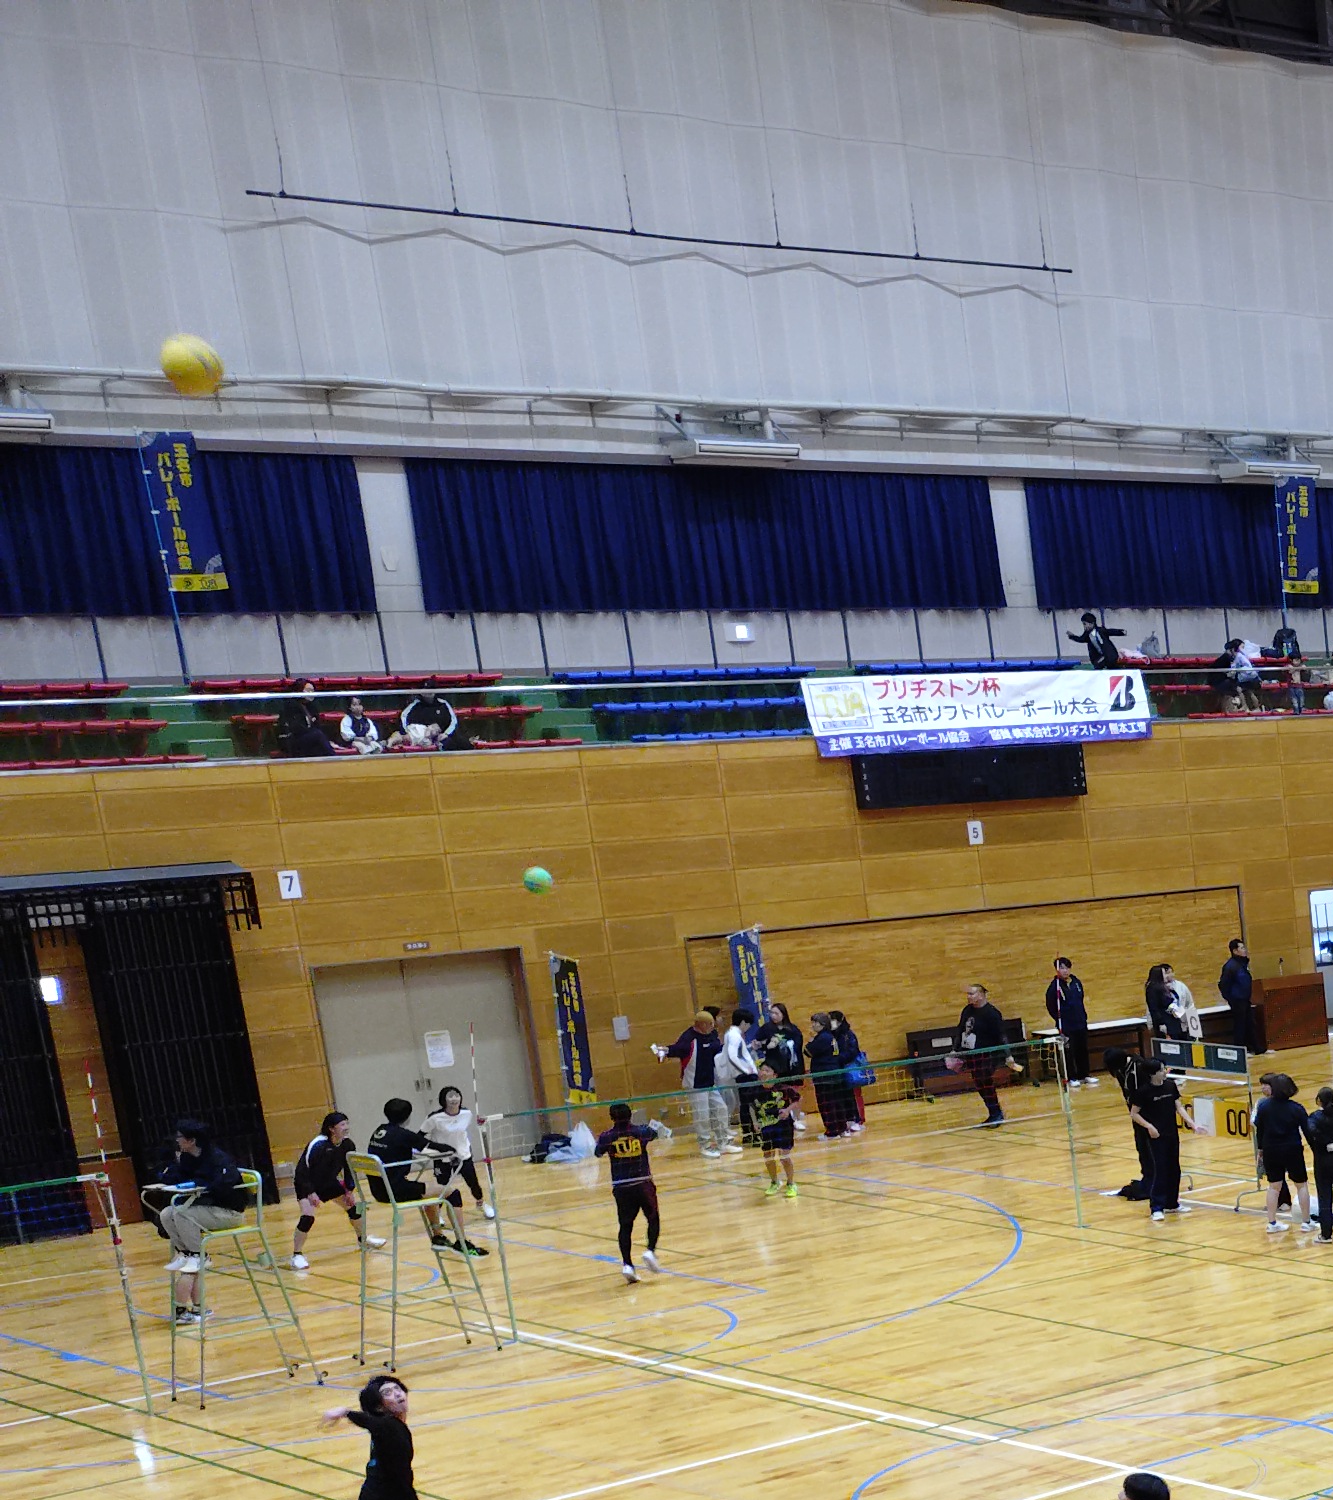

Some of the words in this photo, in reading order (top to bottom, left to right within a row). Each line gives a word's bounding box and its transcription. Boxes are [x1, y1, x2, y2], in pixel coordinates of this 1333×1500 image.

[872, 677, 1001, 700] ブリヂストン杯
[878, 697, 1100, 724] 玉名市ソフトバレーボール大会
[971, 826, 980, 839] 5
[282, 875, 294, 893] 7
[1189, 1015, 1199, 1031] C
[1226, 1109, 1249, 1137] 00
